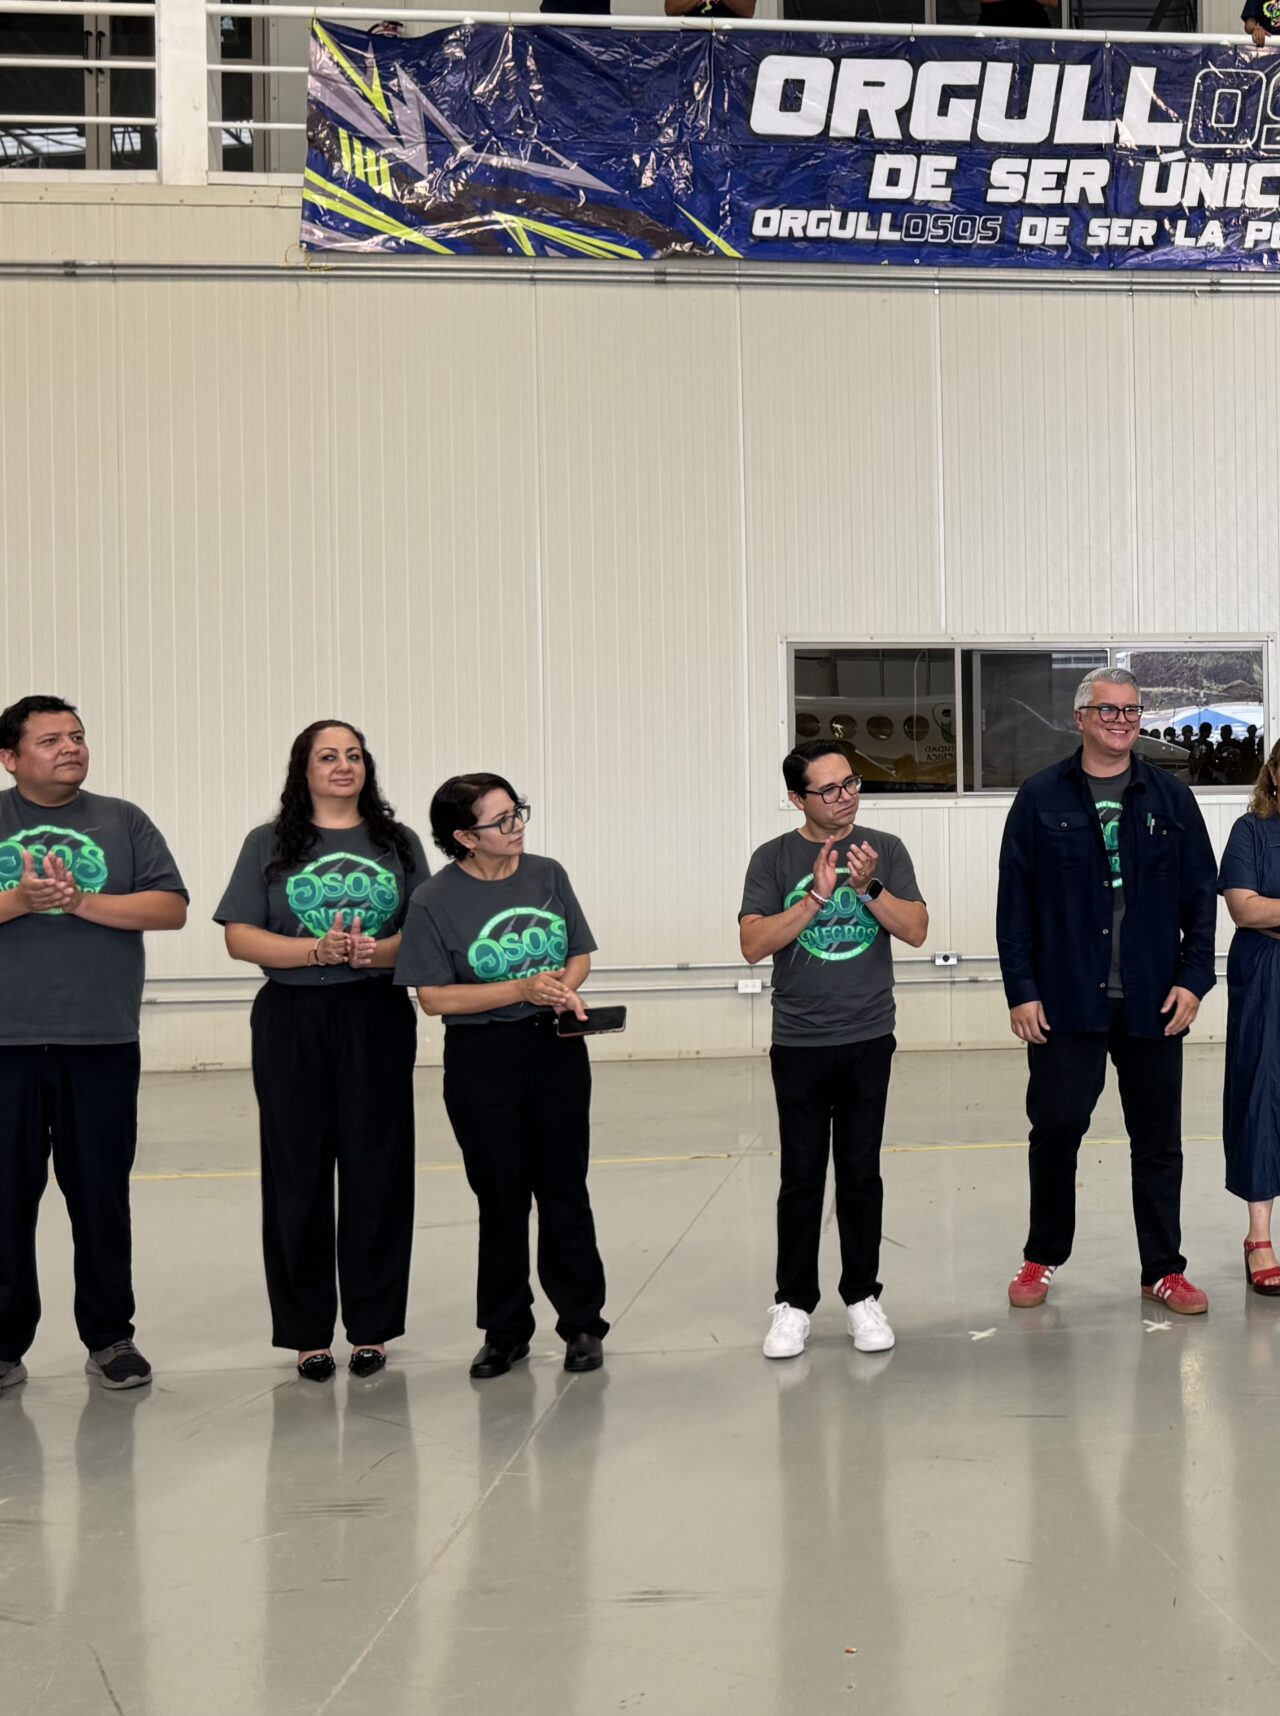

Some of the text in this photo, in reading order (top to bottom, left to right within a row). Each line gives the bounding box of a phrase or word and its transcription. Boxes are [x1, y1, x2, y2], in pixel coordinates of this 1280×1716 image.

[868, 153, 958, 202] DE
[986, 158, 1111, 205] SER
[752, 208, 1003, 244] ORGULLOSOS
[1019, 216, 1070, 246] DE
[1087, 217, 1158, 247] SER
[1174, 219, 1226, 248] LA
[286, 871, 399, 911] OSOS
[467, 919, 568, 979] OSOS
[800, 924, 880, 949] NEGROS
